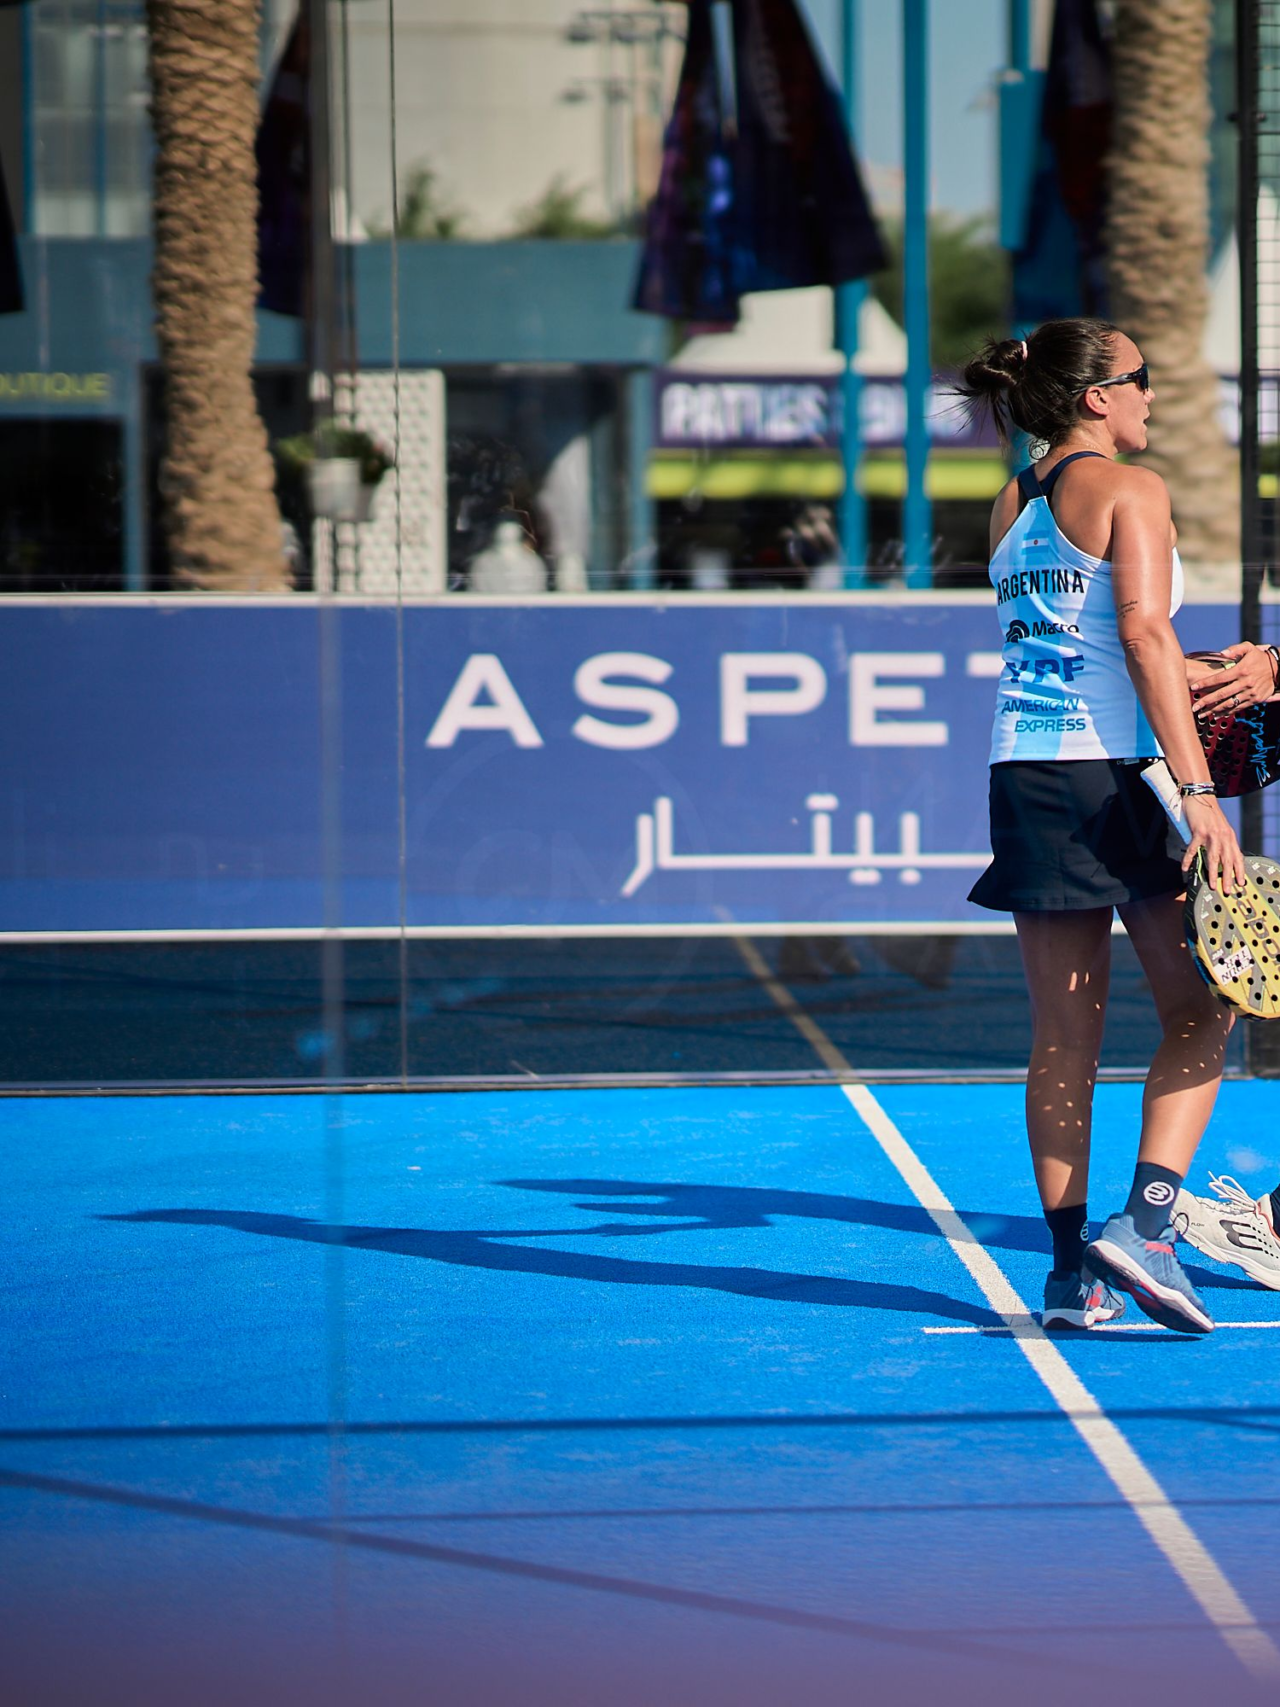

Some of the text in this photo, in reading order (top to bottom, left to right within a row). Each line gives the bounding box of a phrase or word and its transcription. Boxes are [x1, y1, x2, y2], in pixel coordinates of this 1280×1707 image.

[997, 568, 1085, 606] ARGENTINA
[1031, 620, 1080, 638] Macro
[1005, 654, 1085, 684] YPF
[425, 651, 1000, 749] ASPE
[1001, 697, 1079, 714] AMERICAN
[1014, 717, 1087, 733] EXPRESS
